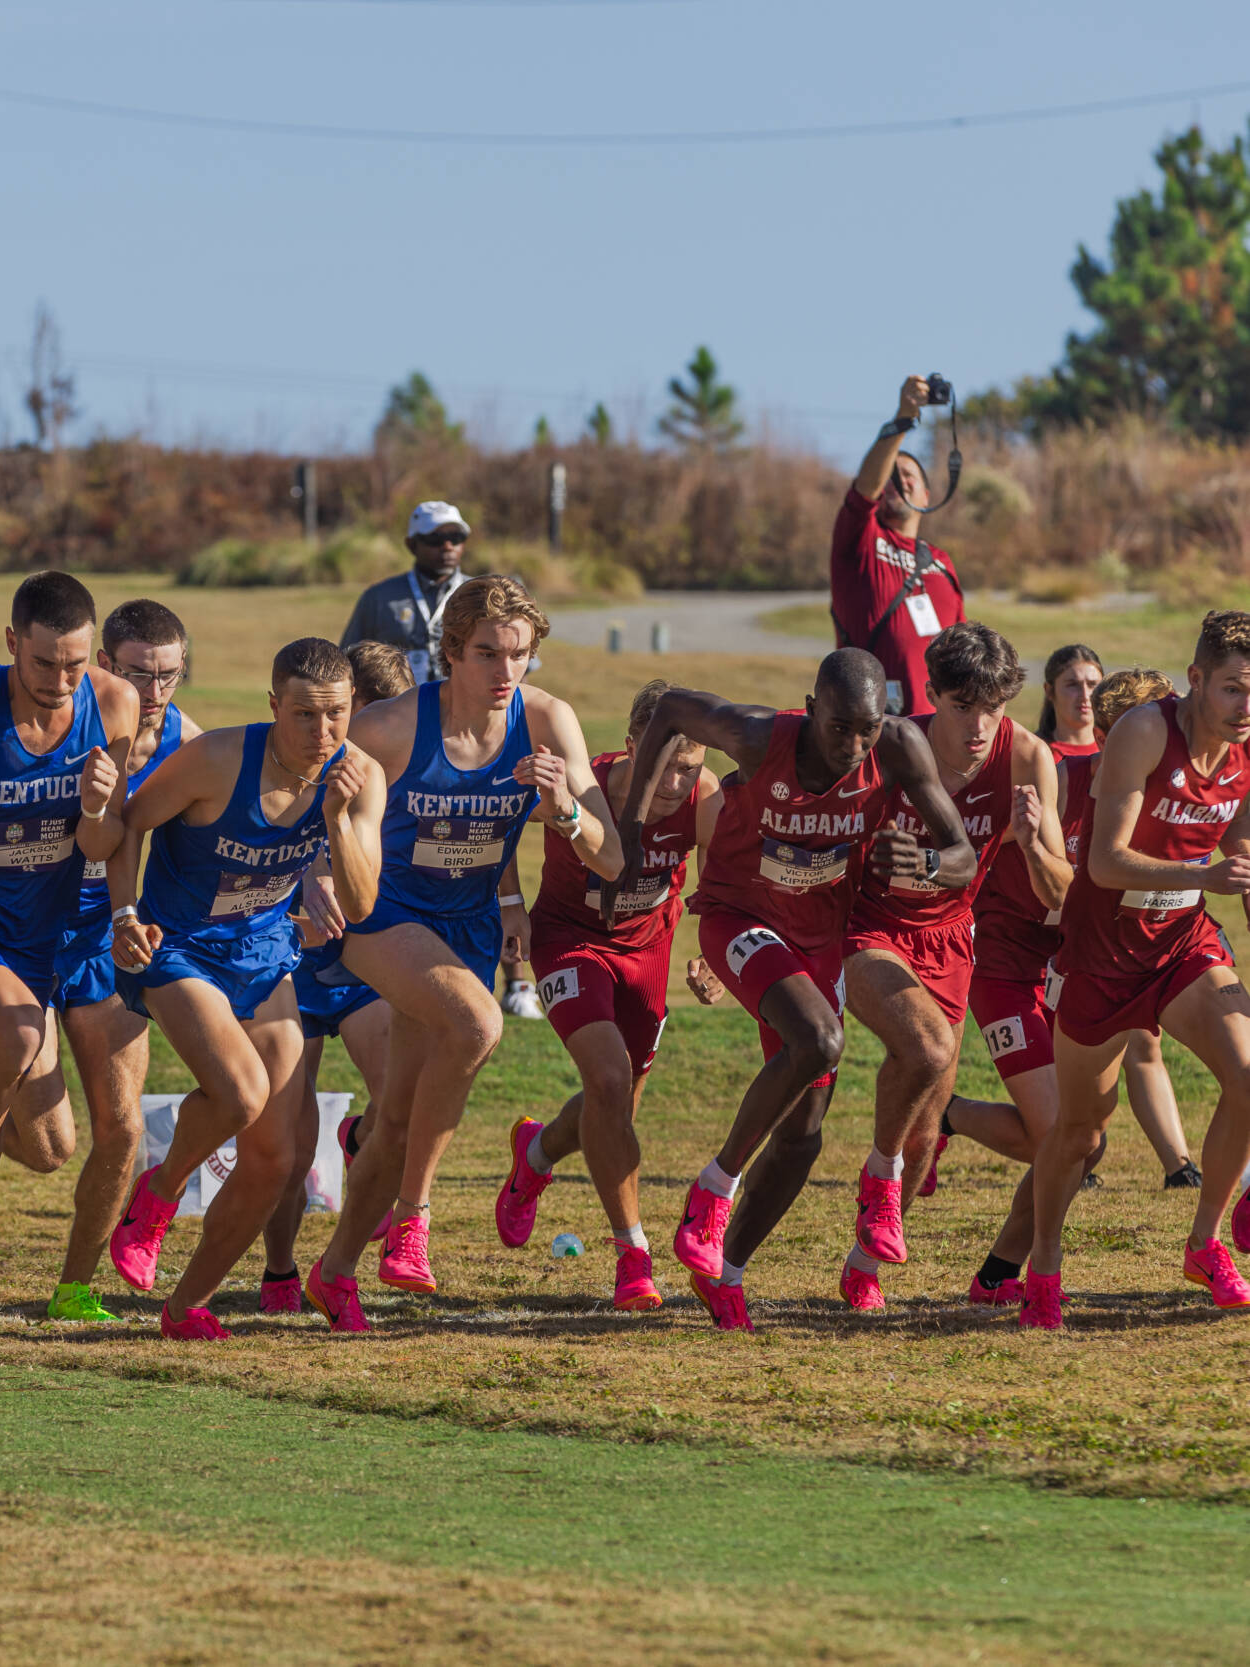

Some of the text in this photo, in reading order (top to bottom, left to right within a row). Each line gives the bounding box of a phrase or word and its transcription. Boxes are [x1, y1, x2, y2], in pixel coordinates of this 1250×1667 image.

[772, 783, 789, 800] SEC
[407, 791, 529, 817] KENTUCKY
[48, 818, 66, 826] JUST
[760, 807, 865, 836] ALABAMA
[895, 811, 992, 836] ALMA
[9, 844, 59, 857] JACKSON
[437, 846, 484, 855] EDWARD
[10, 854, 54, 865] WATTS
[444, 856, 474, 866] BIRD
[785, 867, 824, 877] VICTOR
[780, 875, 827, 885] KIPROP
[911, 880, 943, 890] HAR
[243, 891, 270, 899] ALEX
[230, 898, 278, 912] ALSTON
[1142, 898, 1184, 908] HARRIS
[732, 930, 777, 959] 116
